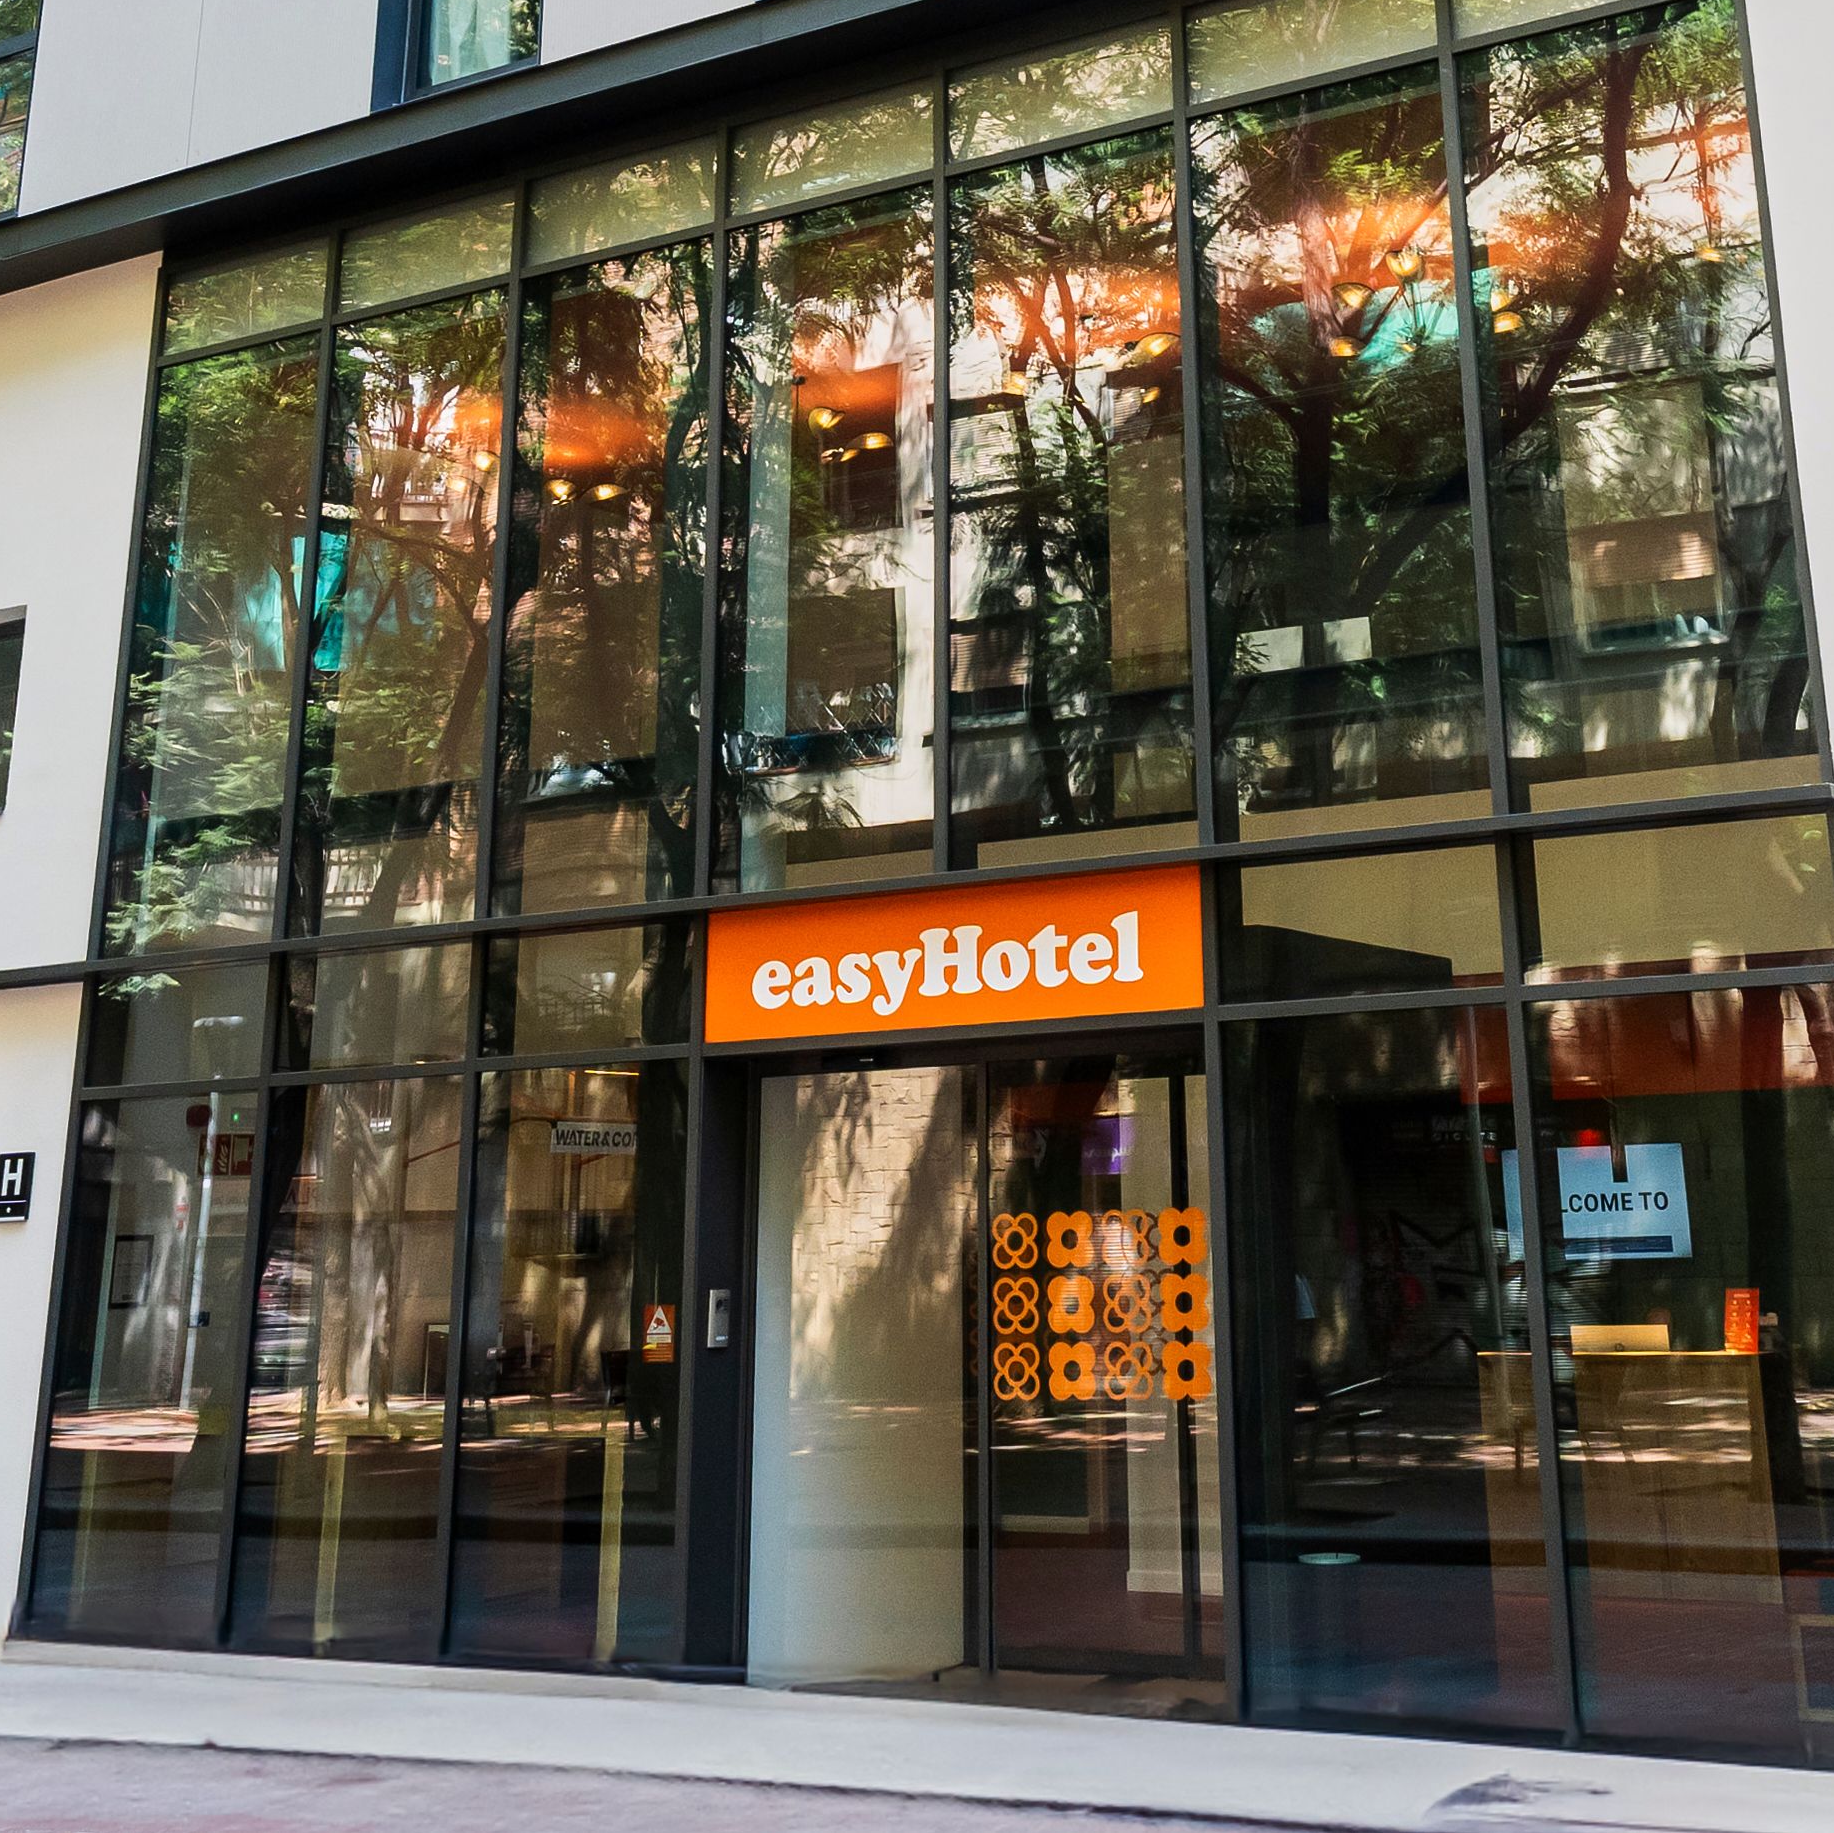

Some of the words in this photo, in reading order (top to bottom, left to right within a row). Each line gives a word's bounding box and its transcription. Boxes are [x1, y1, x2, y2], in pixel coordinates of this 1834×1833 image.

[751, 910, 1145, 1016] easyHotel
[1, 1158, 24, 1197] H
[1638, 1191, 1669, 1211] TO
